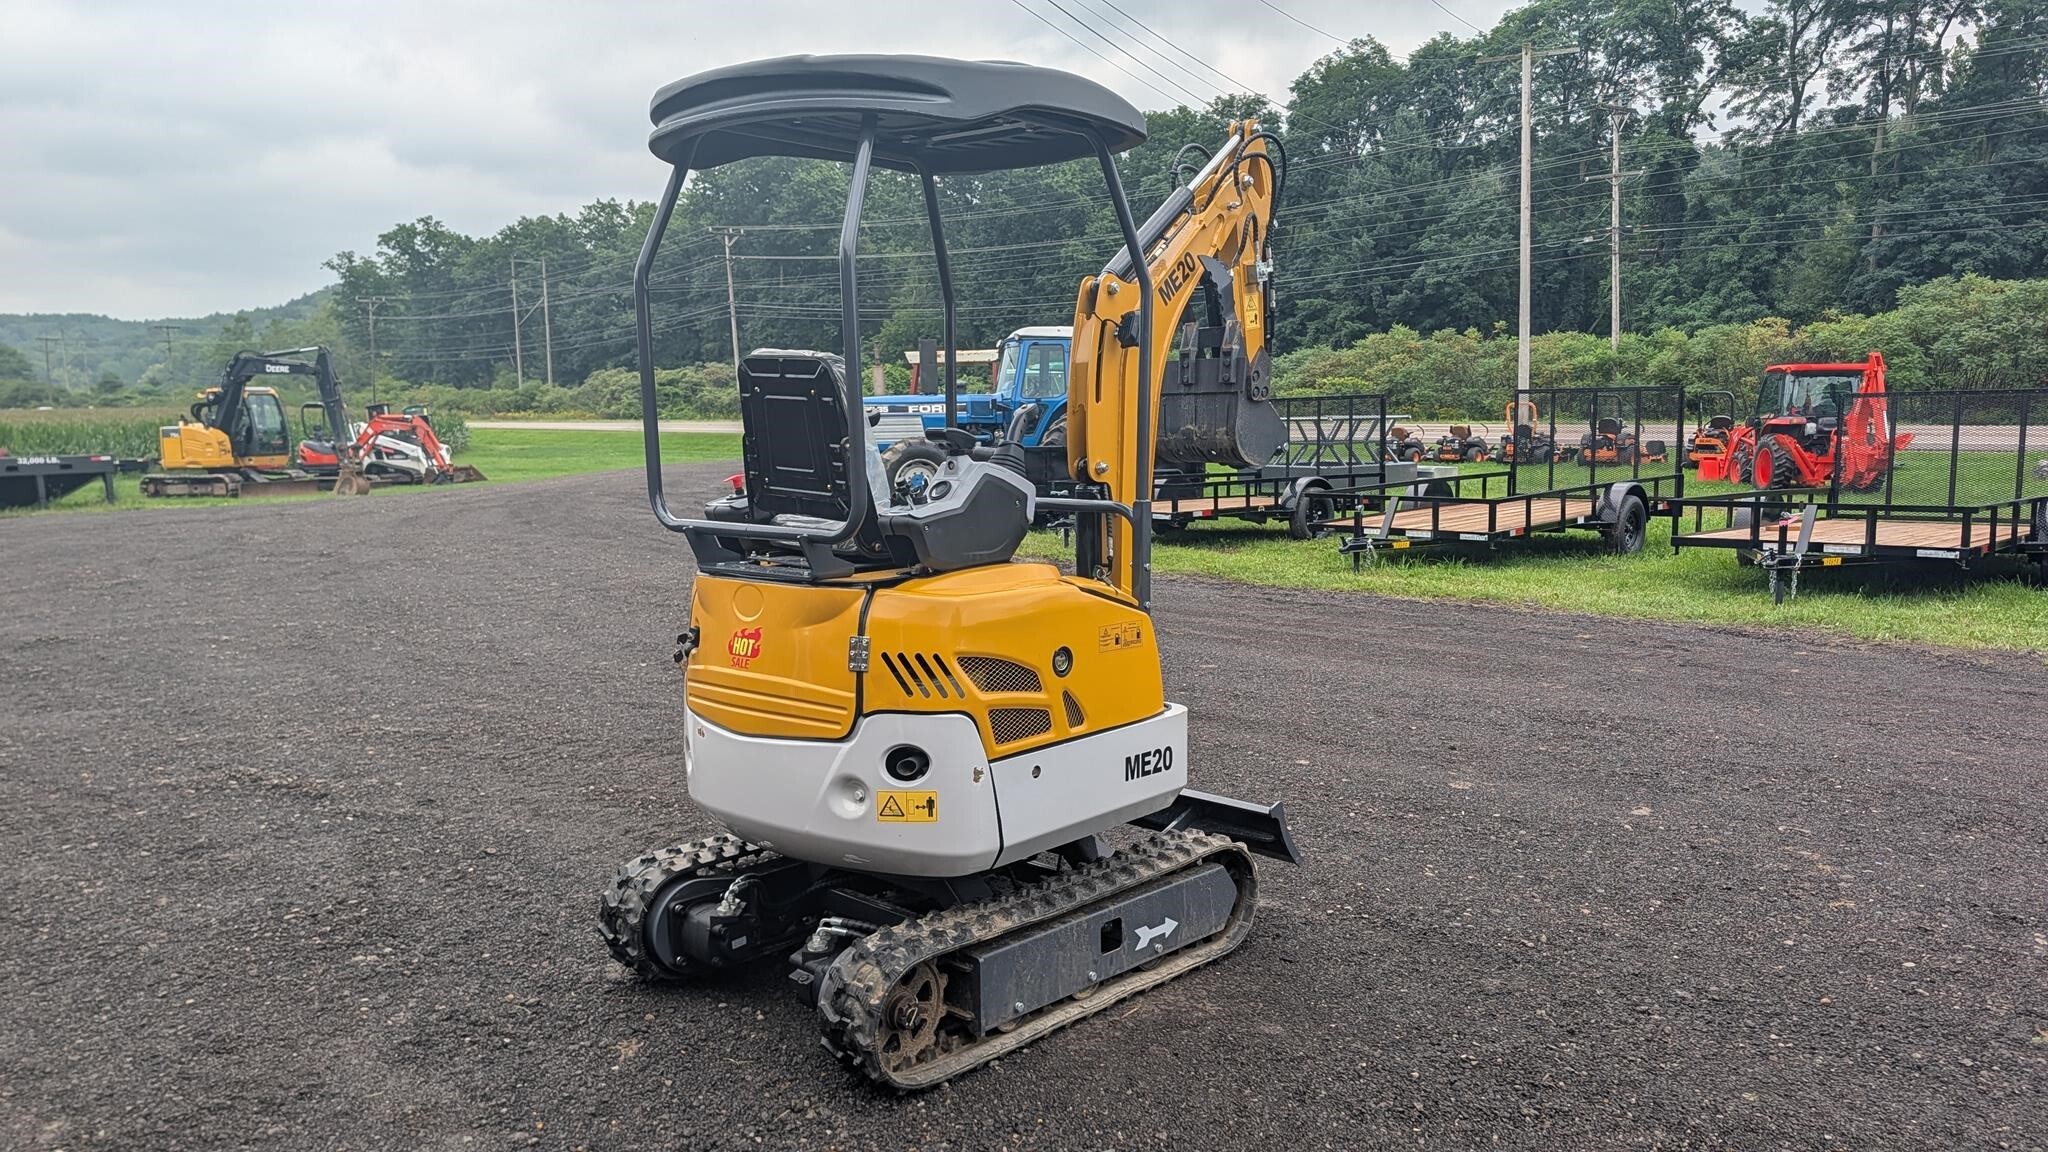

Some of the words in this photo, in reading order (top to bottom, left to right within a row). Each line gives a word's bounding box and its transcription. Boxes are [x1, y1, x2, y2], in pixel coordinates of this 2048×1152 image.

[1158, 251, 1196, 306] ME20
[265, 364, 290, 373] DEERE
[908, 404, 946, 414] FOR
[732, 636, 756, 657] HOT
[730, 656, 751, 670] SALE
[1125, 745, 1173, 782] ME20
